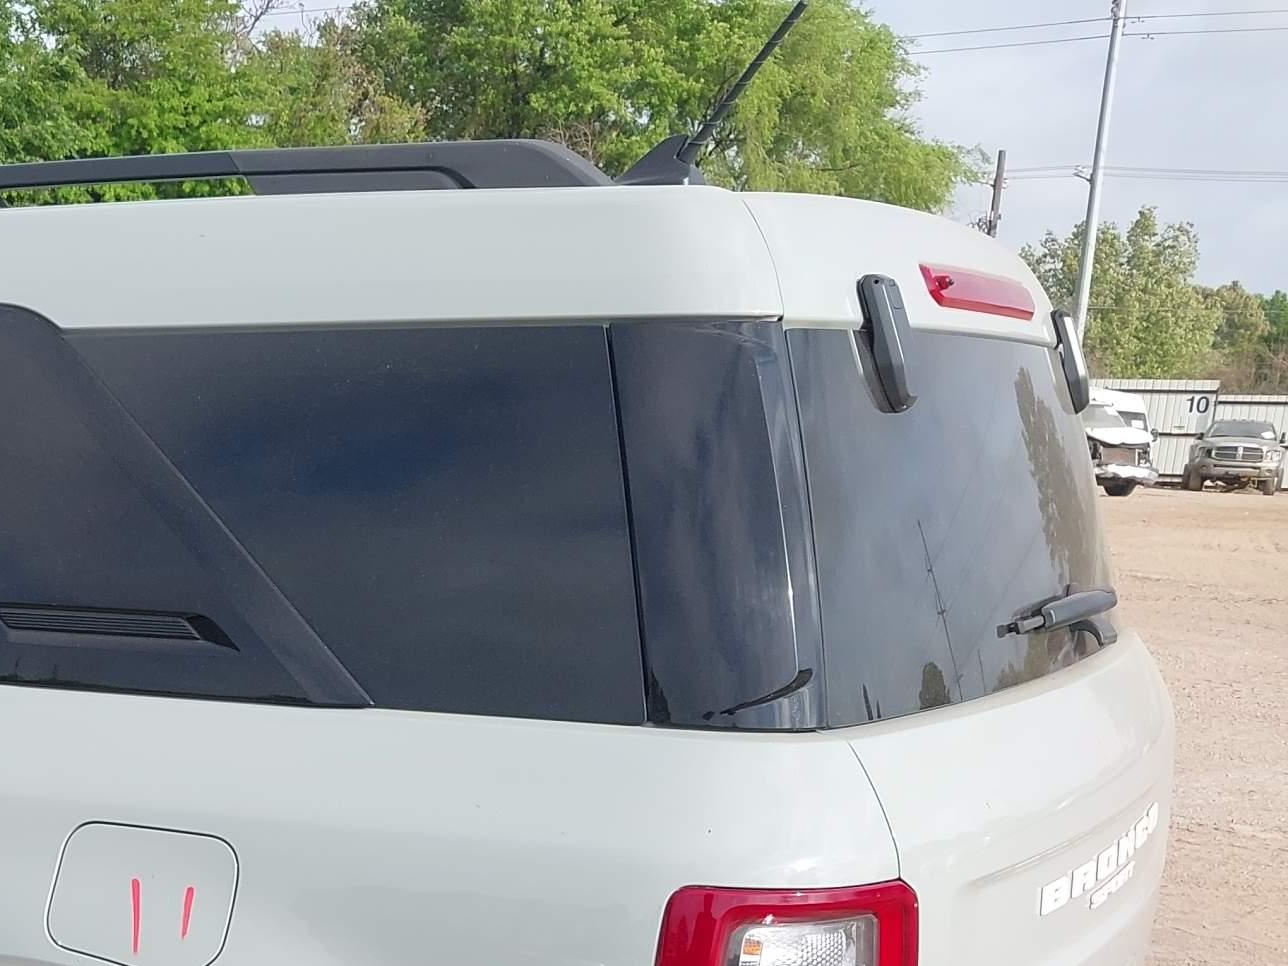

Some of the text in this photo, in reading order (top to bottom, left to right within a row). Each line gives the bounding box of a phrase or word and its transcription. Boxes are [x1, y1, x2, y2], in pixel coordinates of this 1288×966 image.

[1186, 395, 1210, 414] 10
[1039, 801, 1159, 917] BRONCO
[1088, 860, 1136, 910] SPORT
